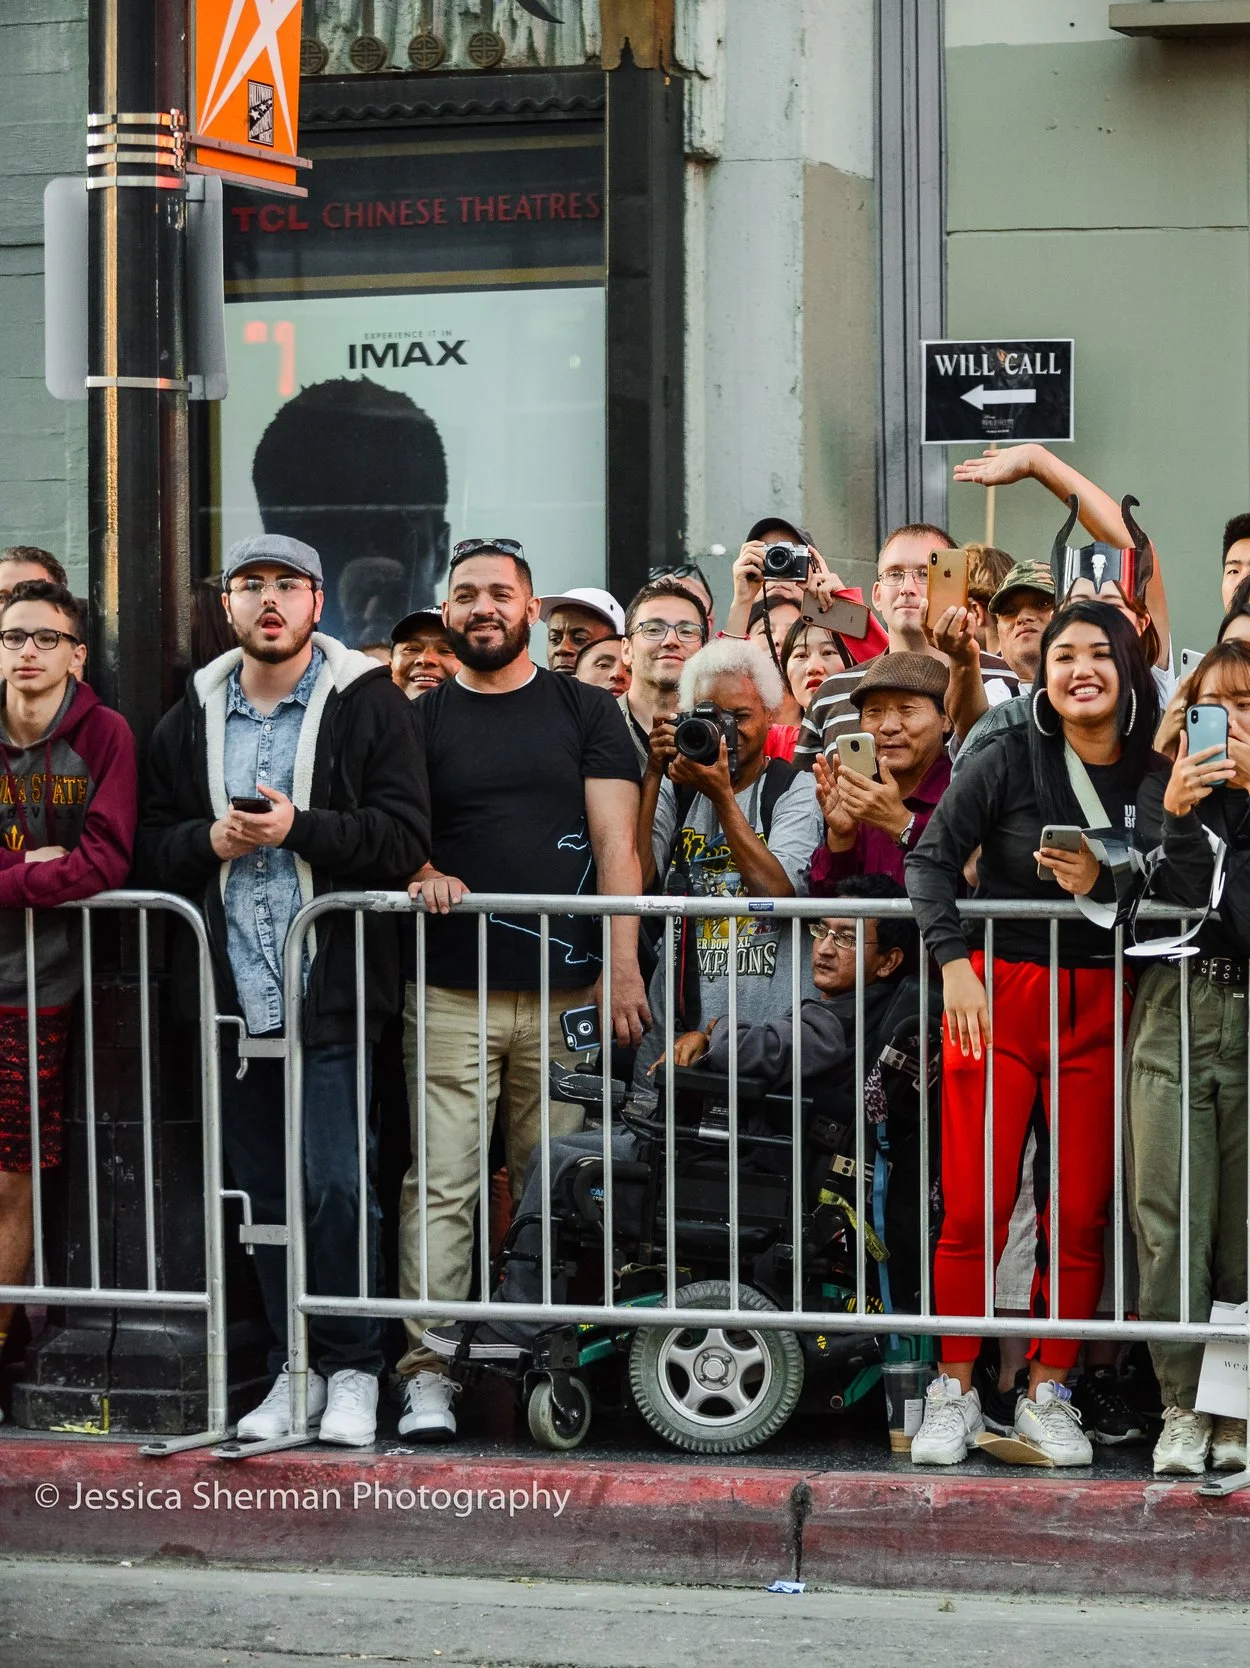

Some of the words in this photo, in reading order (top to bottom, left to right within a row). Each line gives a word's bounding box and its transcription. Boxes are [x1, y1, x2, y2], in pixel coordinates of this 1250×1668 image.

[231, 204, 310, 232] TCL
[322, 198, 447, 230] CHINESE
[456, 193, 600, 223] THEATRES
[364, 330, 423, 340] EXPERIENCE
[348, 340, 469, 369] IMAX
[934, 353, 995, 376] WILL
[1004, 352, 1062, 375] CALL
[31, 773, 88, 805] SATE
[710, 937, 730, 950] BOW
[737, 936, 751, 950] XL
[696, 942, 778, 977] MPIONS
